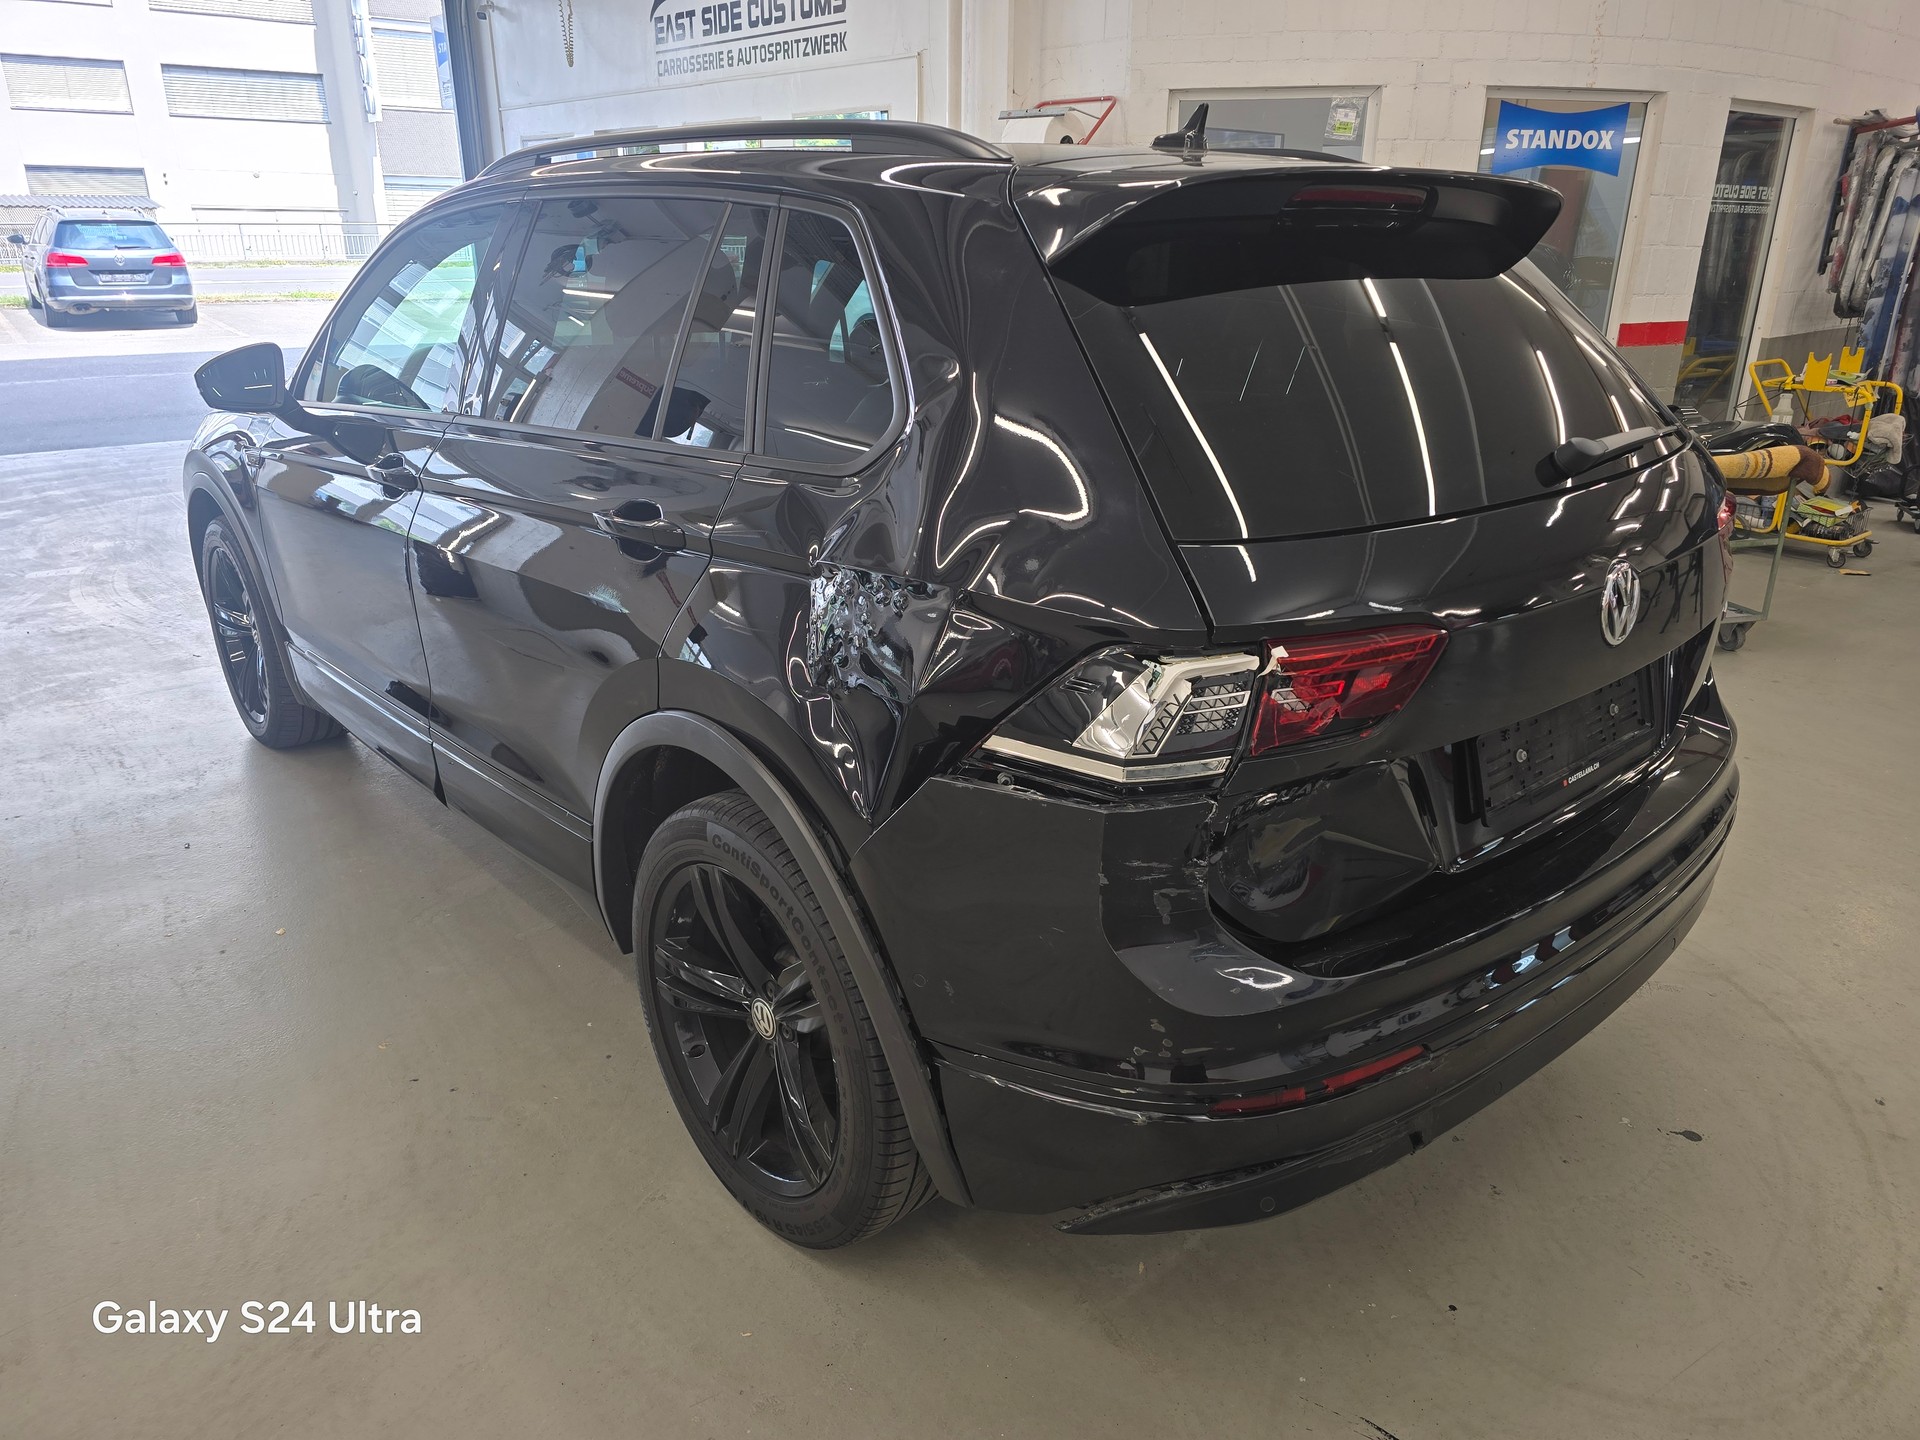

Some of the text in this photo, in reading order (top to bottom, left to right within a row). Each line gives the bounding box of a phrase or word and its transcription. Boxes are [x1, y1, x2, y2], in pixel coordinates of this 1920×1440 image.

[655, 9, 696, 45] EAST
[702, 0, 743, 37] SIDE
[657, 31, 848, 77] CARROSSERIE & AUTOSPRITZWERK
[1505, 128, 1615, 150] STANDOX
[1568, 761, 1600, 784] CASTELLANA.CH
